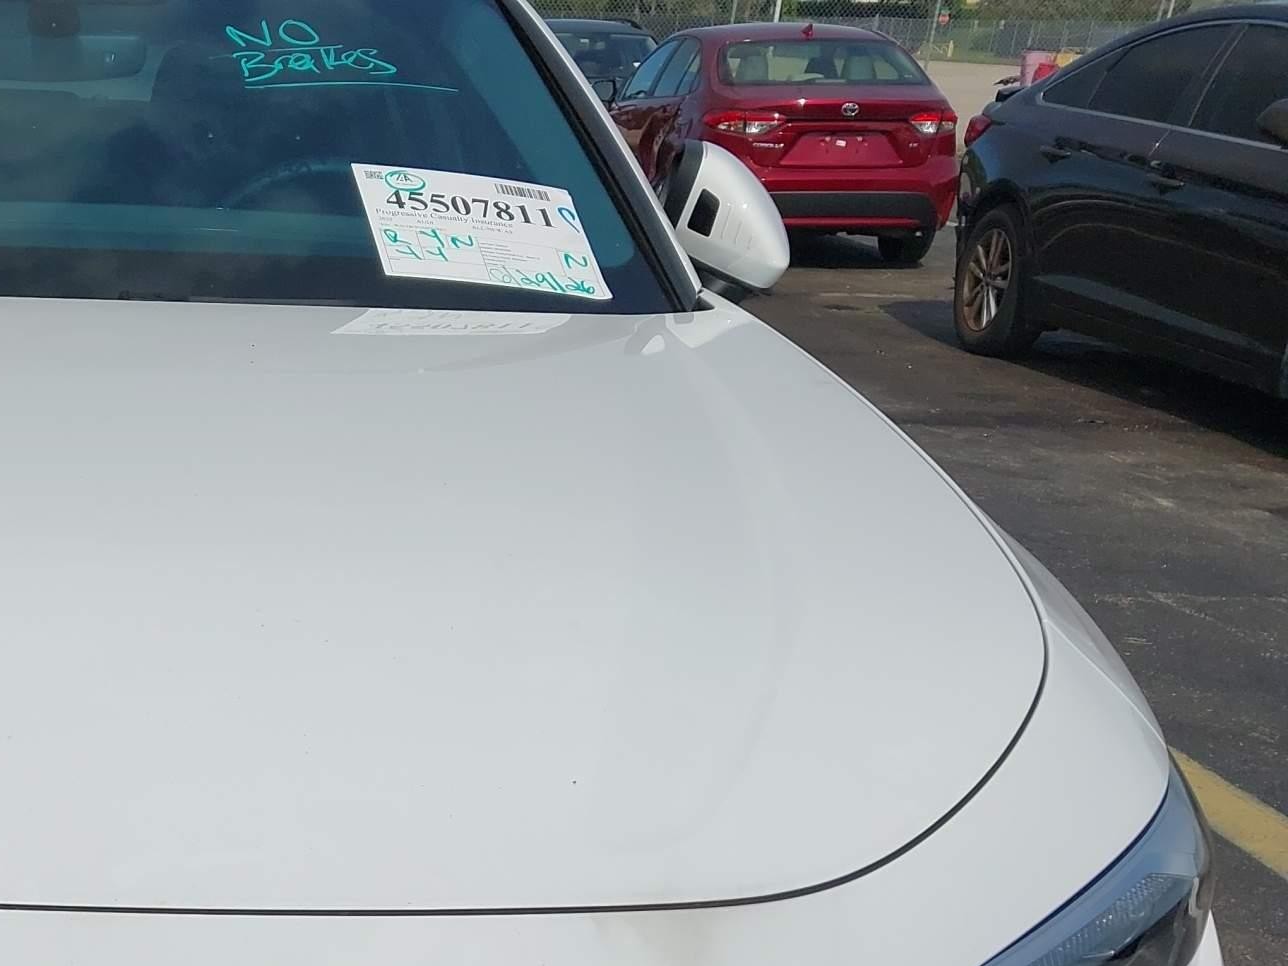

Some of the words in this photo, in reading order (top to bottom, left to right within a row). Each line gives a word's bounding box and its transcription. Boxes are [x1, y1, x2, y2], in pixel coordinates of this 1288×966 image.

[224, 18, 320, 47] NO
[375, 207, 429, 219] Progressive
[430, 212, 469, 224] Casualty
[471, 217, 514, 229] Insurance
[386, 189, 557, 228] 45507811
